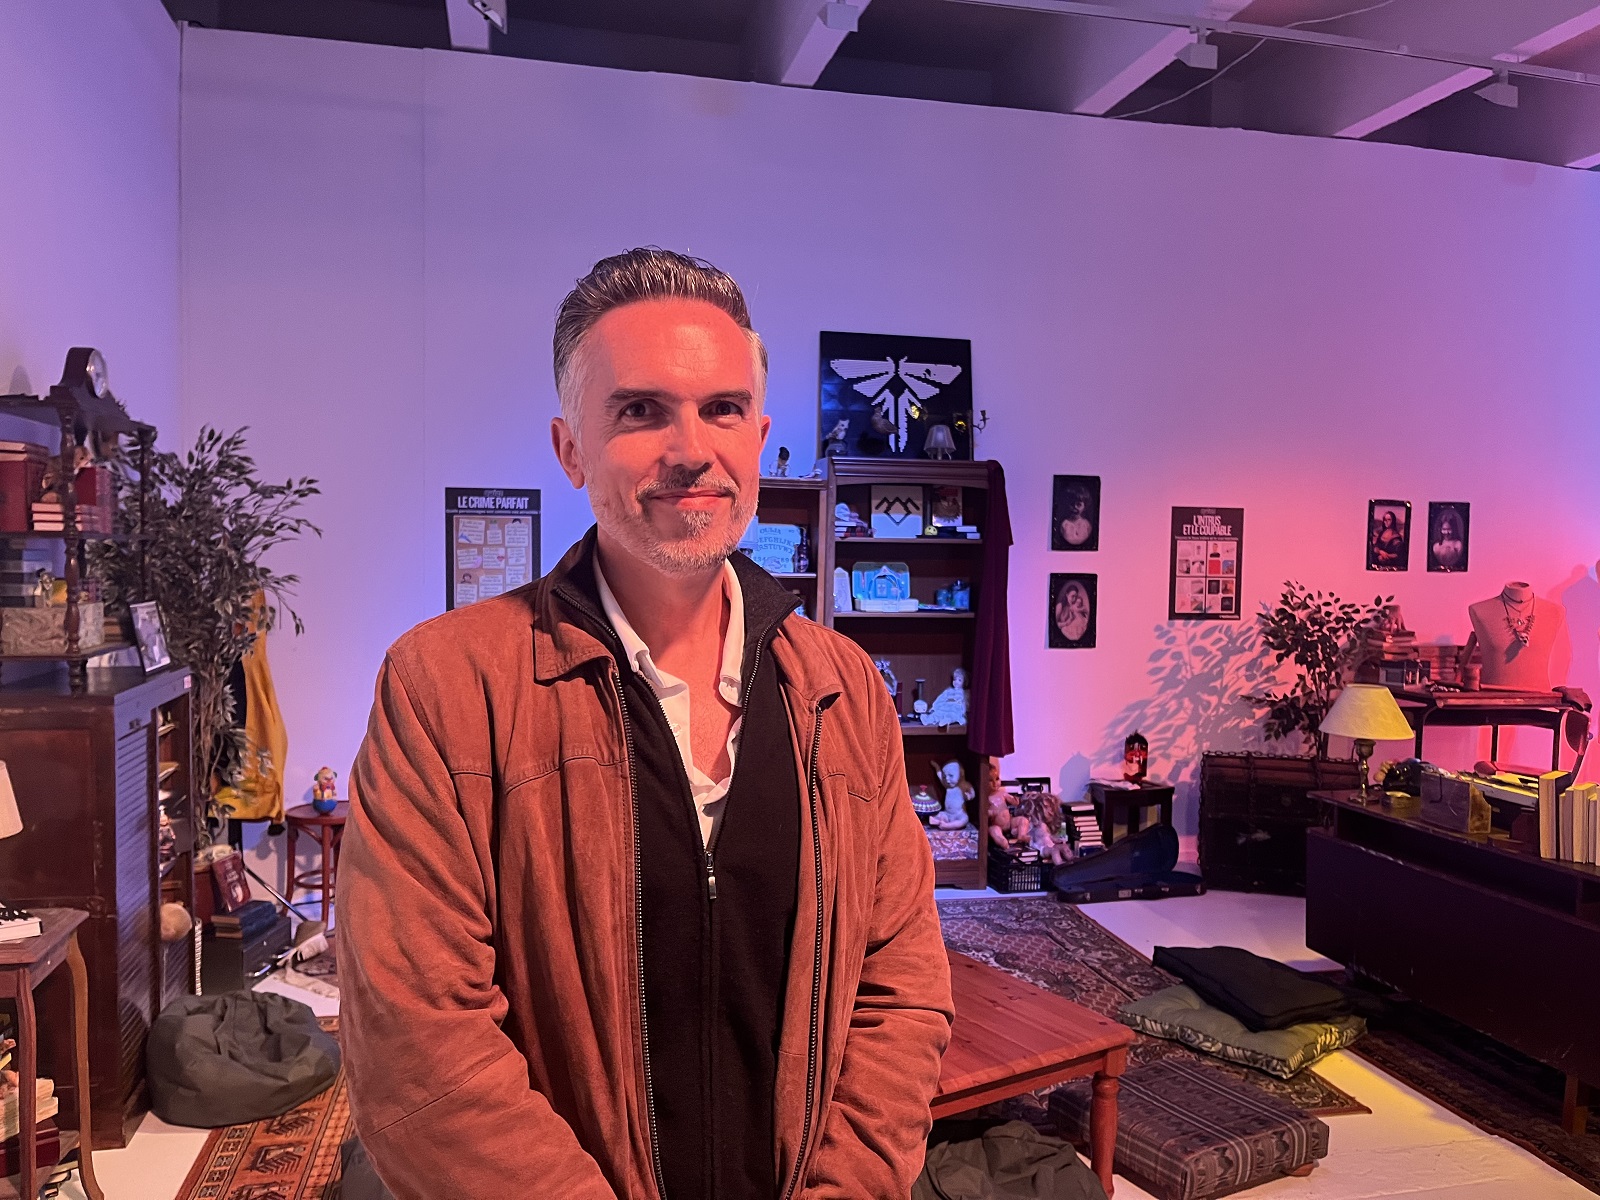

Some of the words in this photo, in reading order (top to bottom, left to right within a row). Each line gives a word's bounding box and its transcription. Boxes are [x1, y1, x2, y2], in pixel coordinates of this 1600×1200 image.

[457, 496, 468, 509] LE
[468, 496, 495, 509] CRIME
[496, 497, 529, 509] PARFAIT
[1193, 515, 1221, 527] L'INTRUS
[1183, 524, 1191, 536] ET
[1191, 525, 1200, 536] LE
[1200, 525, 1232, 536] COUPABLE
